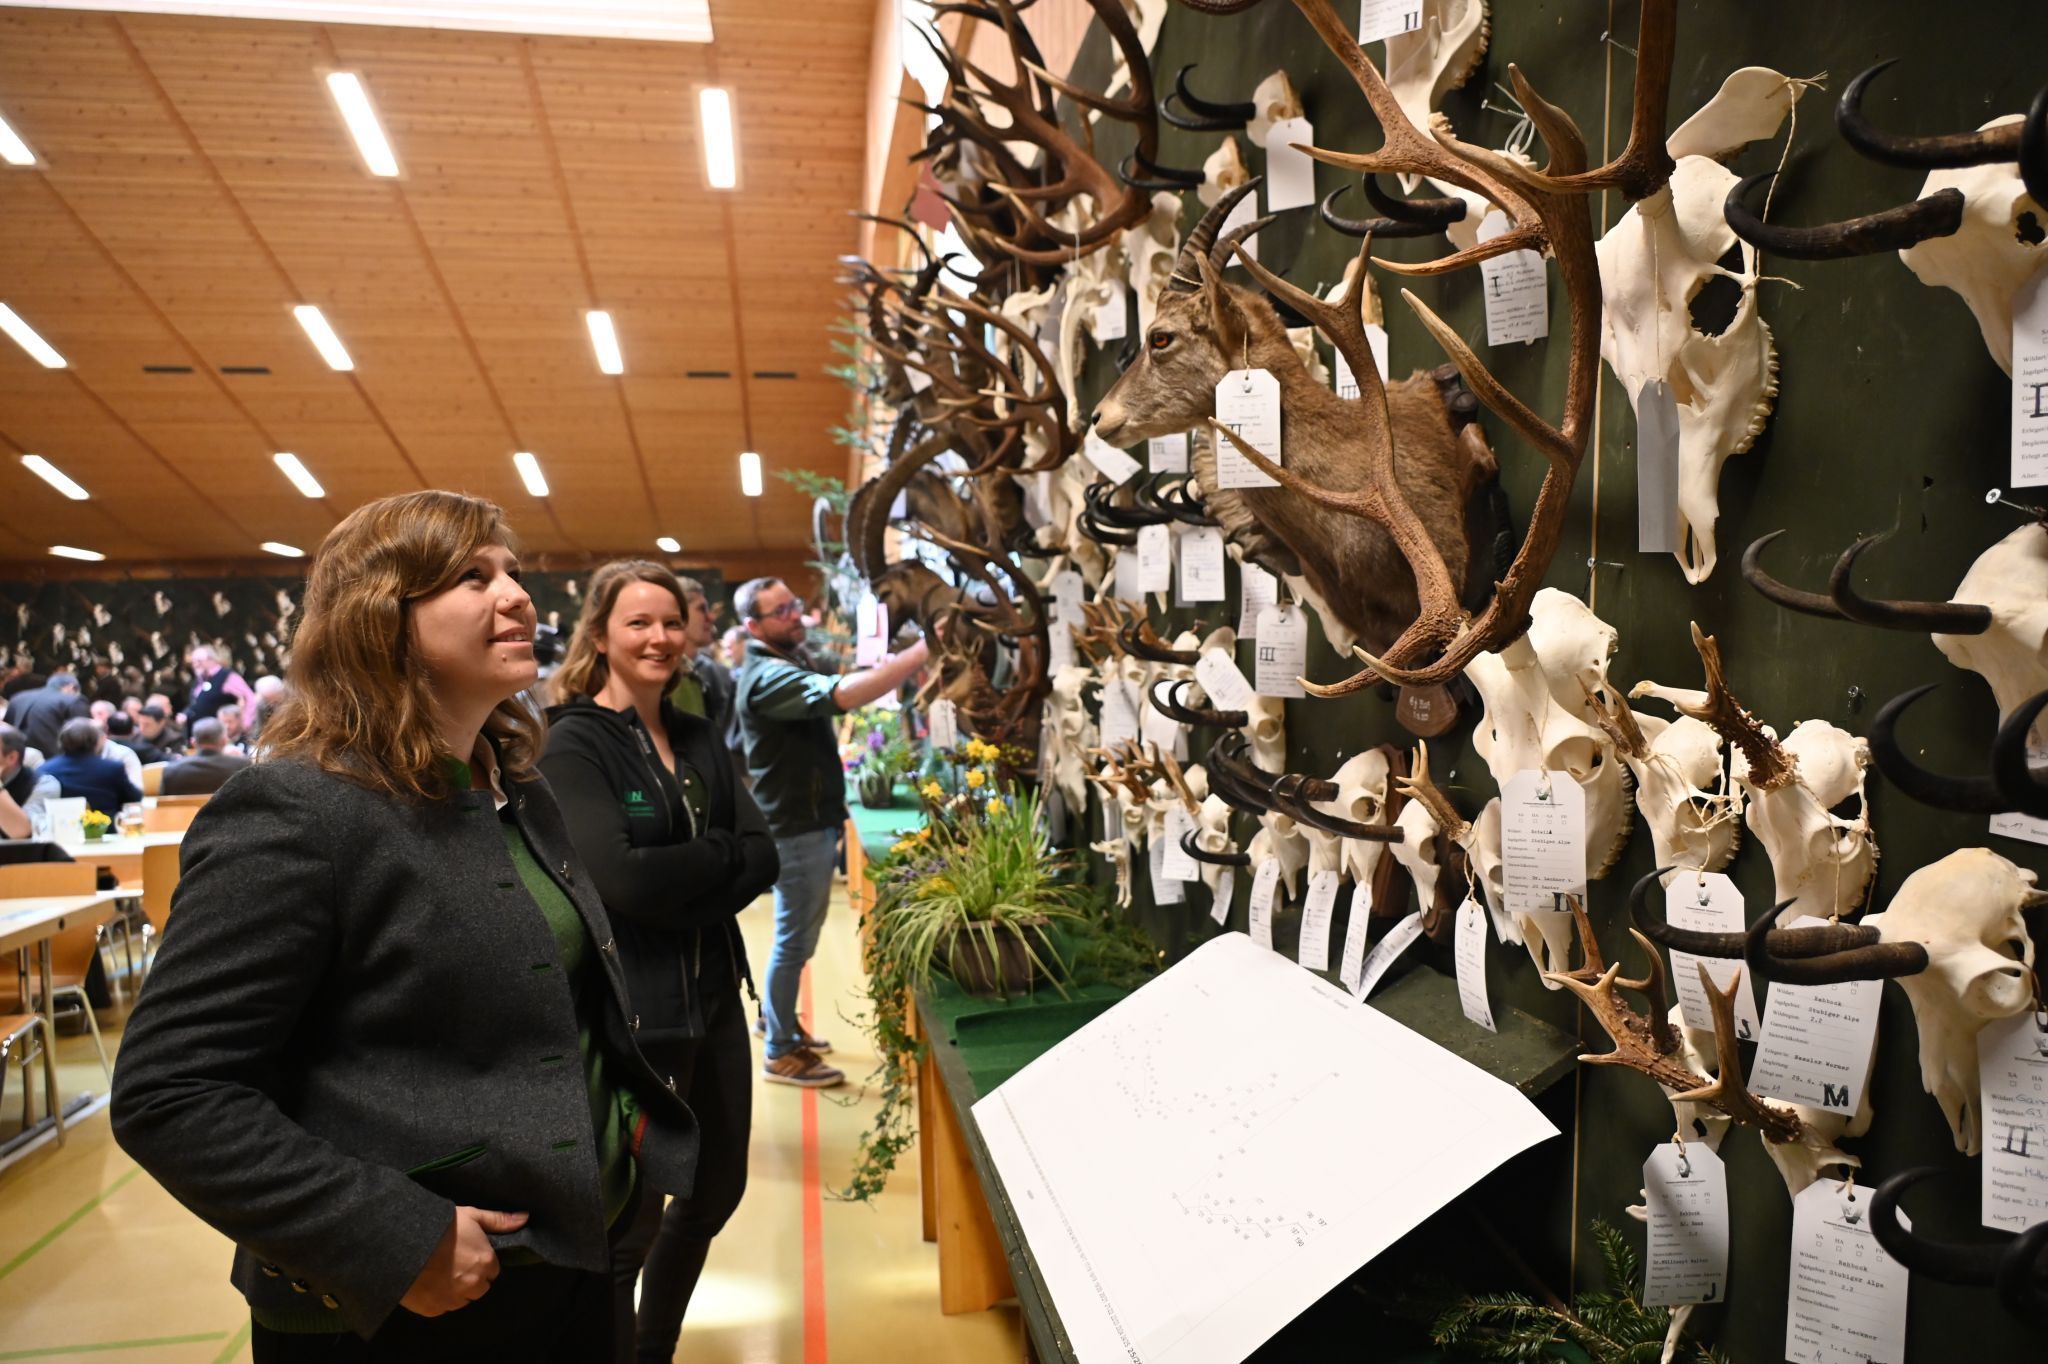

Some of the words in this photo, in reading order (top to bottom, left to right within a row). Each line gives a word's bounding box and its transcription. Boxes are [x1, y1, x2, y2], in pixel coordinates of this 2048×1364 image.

[1823, 1083, 1849, 1107] M
[1866, 1278, 1884, 1289] Alpe
[1127, 1346, 1143, 1364] 25/2
